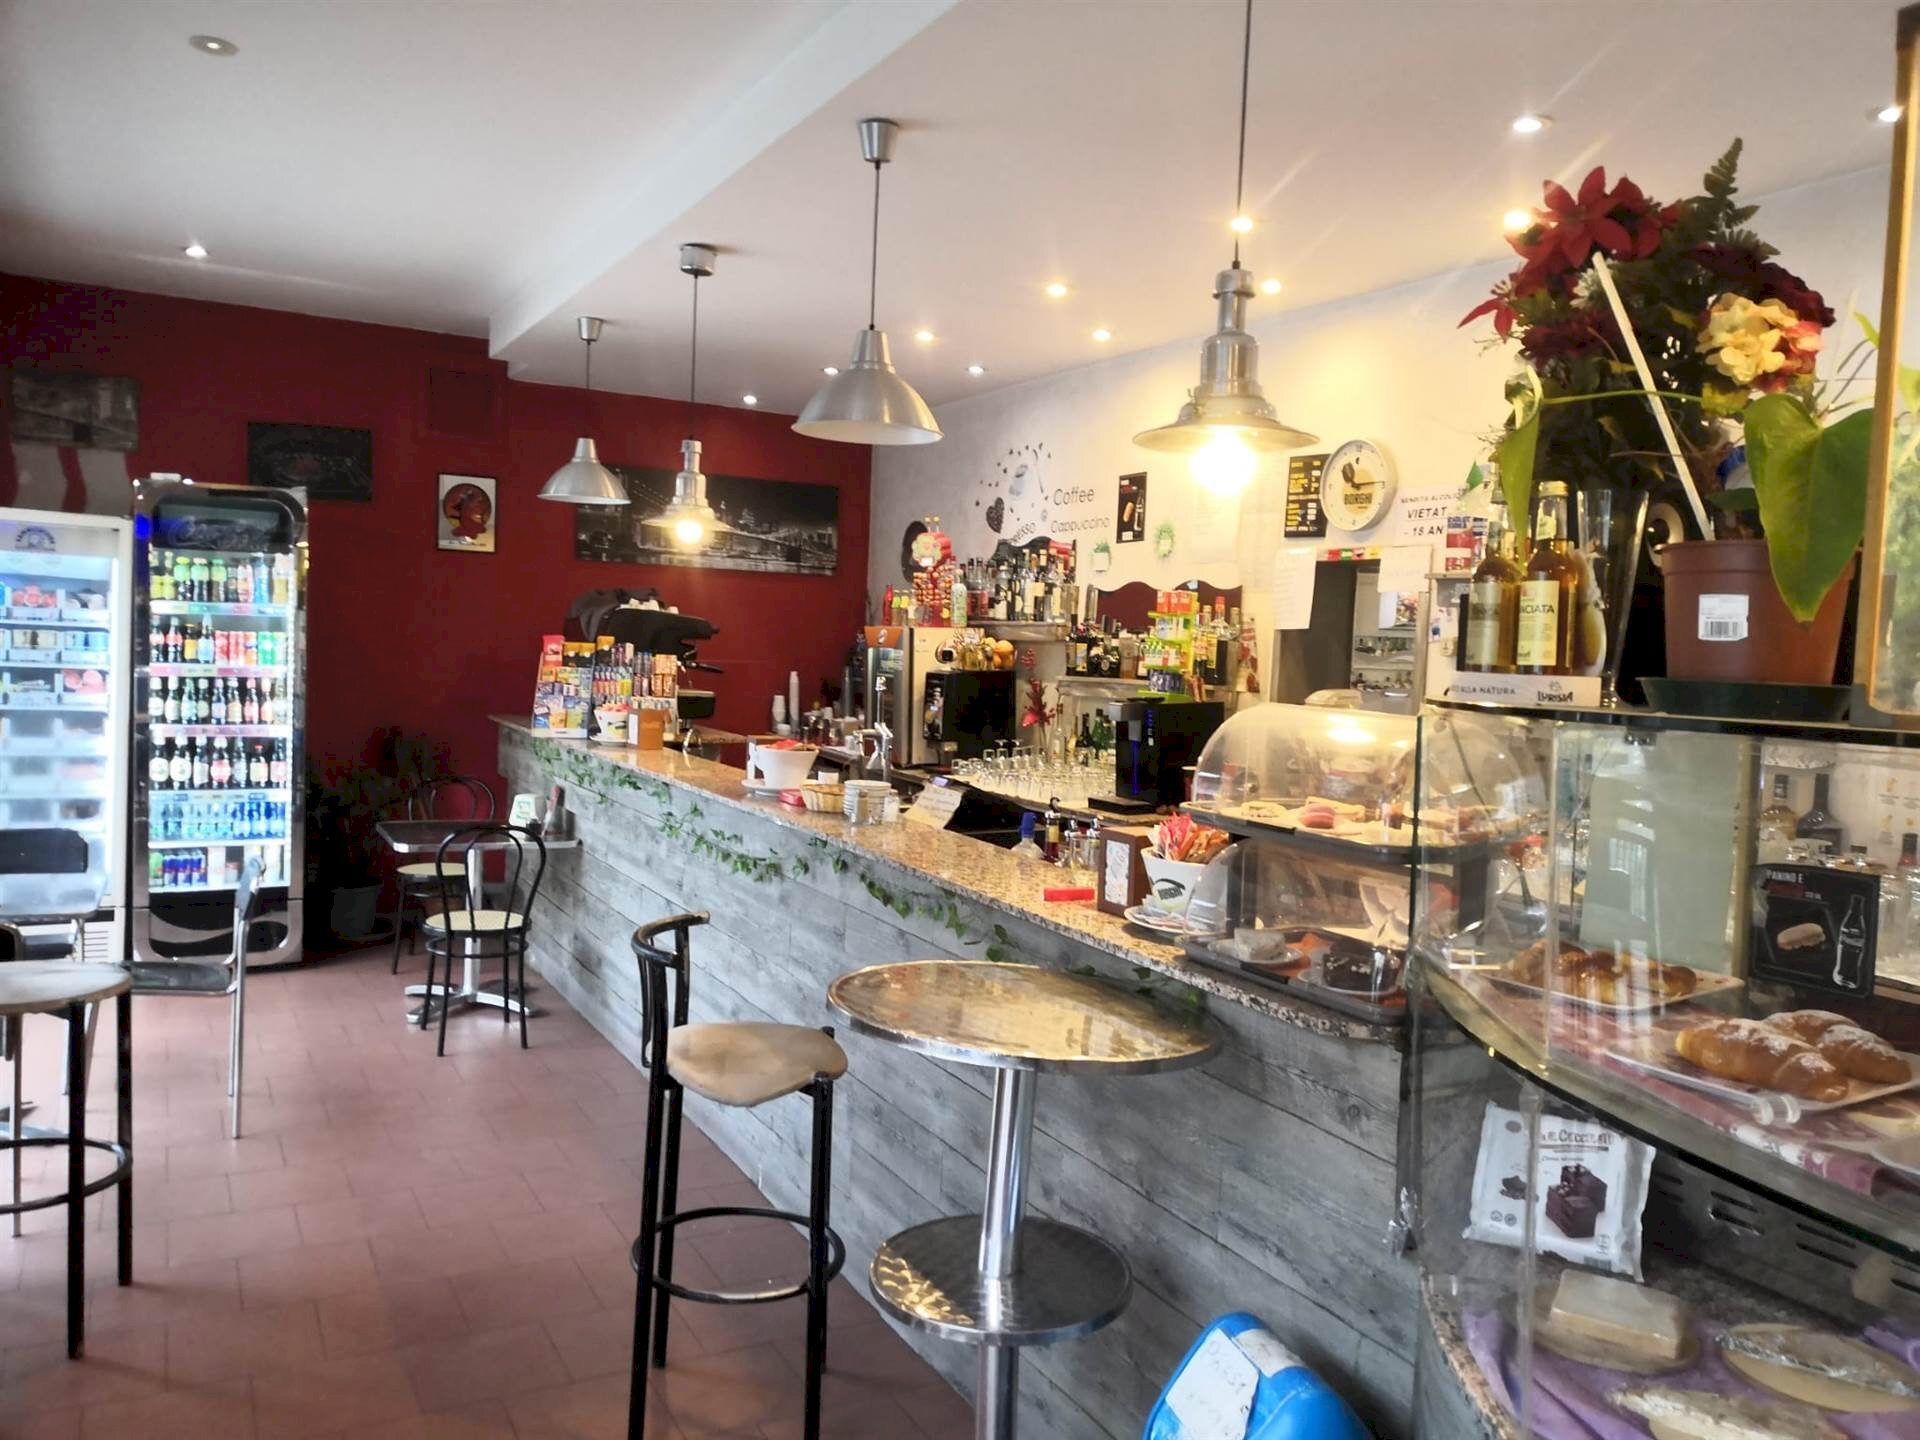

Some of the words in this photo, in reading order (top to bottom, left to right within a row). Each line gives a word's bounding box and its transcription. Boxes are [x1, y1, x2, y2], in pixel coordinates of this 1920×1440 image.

[1053, 487, 1095, 505] Coffee
[1407, 506, 1448, 519] VIETAT
[1050, 516, 1111, 534] Cappuccino
[1427, 525, 1445, 535] AN
